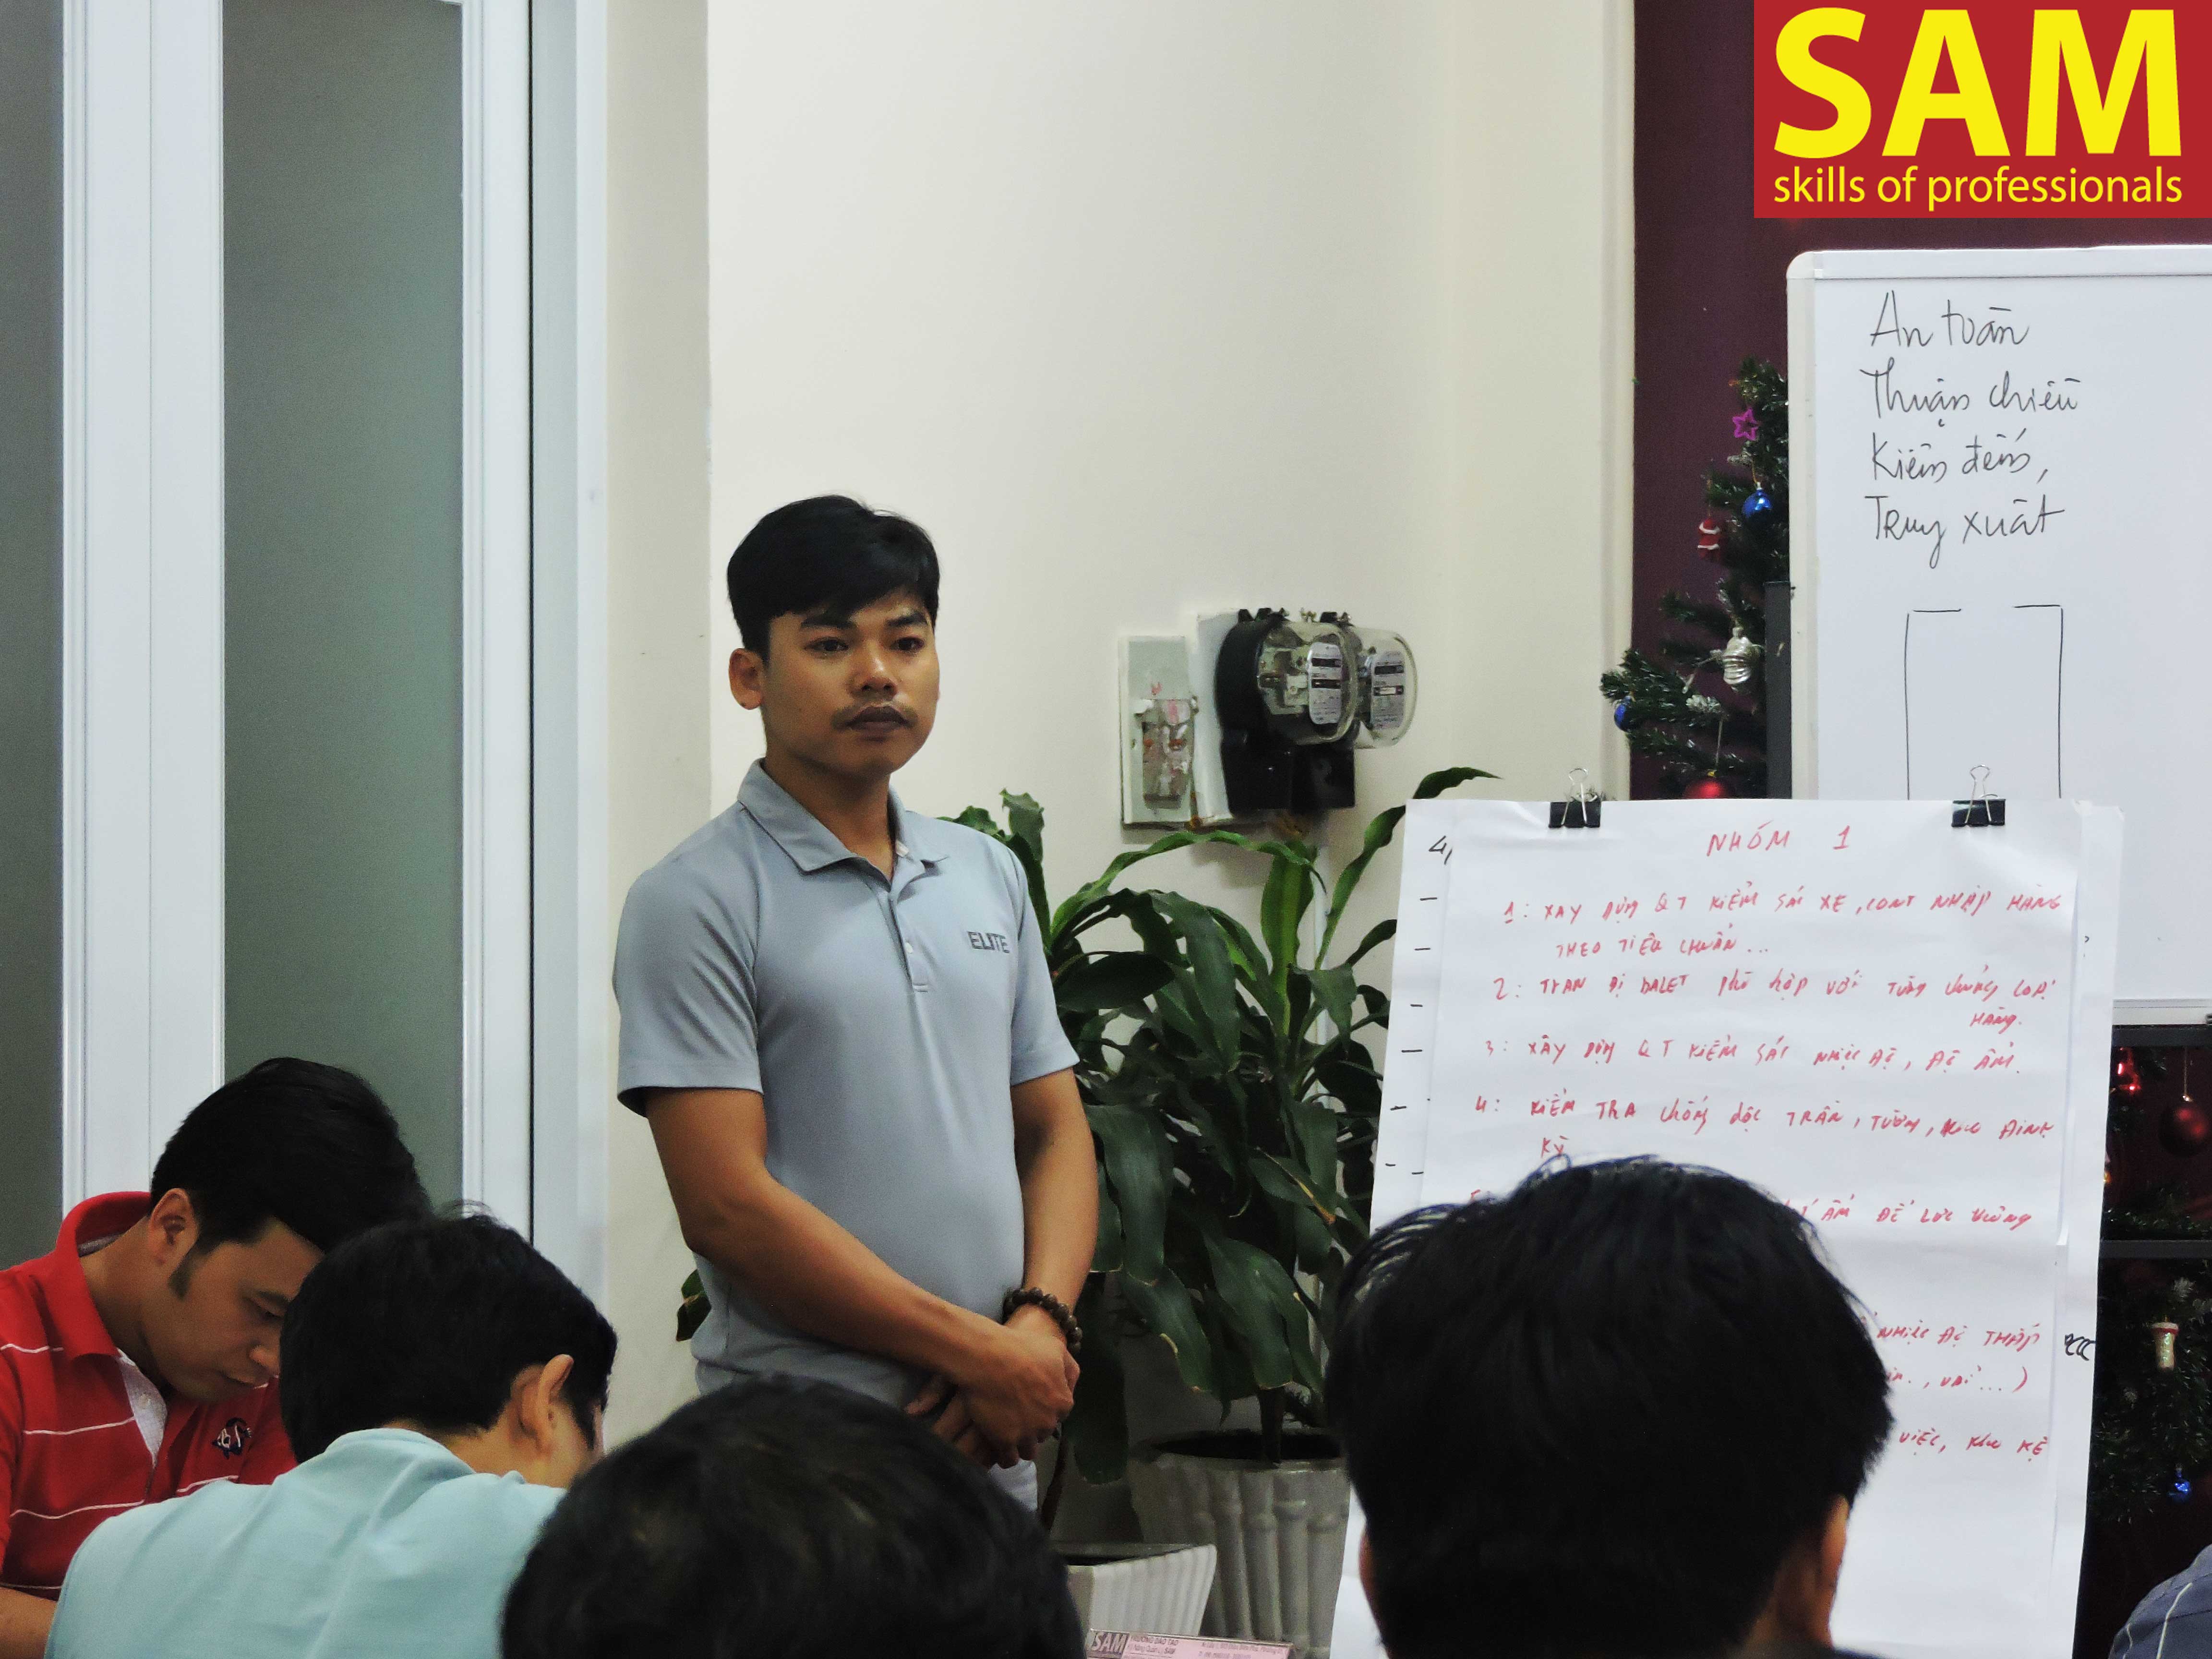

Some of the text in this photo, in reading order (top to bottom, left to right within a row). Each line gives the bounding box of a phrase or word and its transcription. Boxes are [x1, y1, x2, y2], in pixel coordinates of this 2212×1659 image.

[1870, 289, 1934, 348] An
[1706, 821, 1850, 857] NHÓM 1
[967, 931, 1010, 954] ELITE
